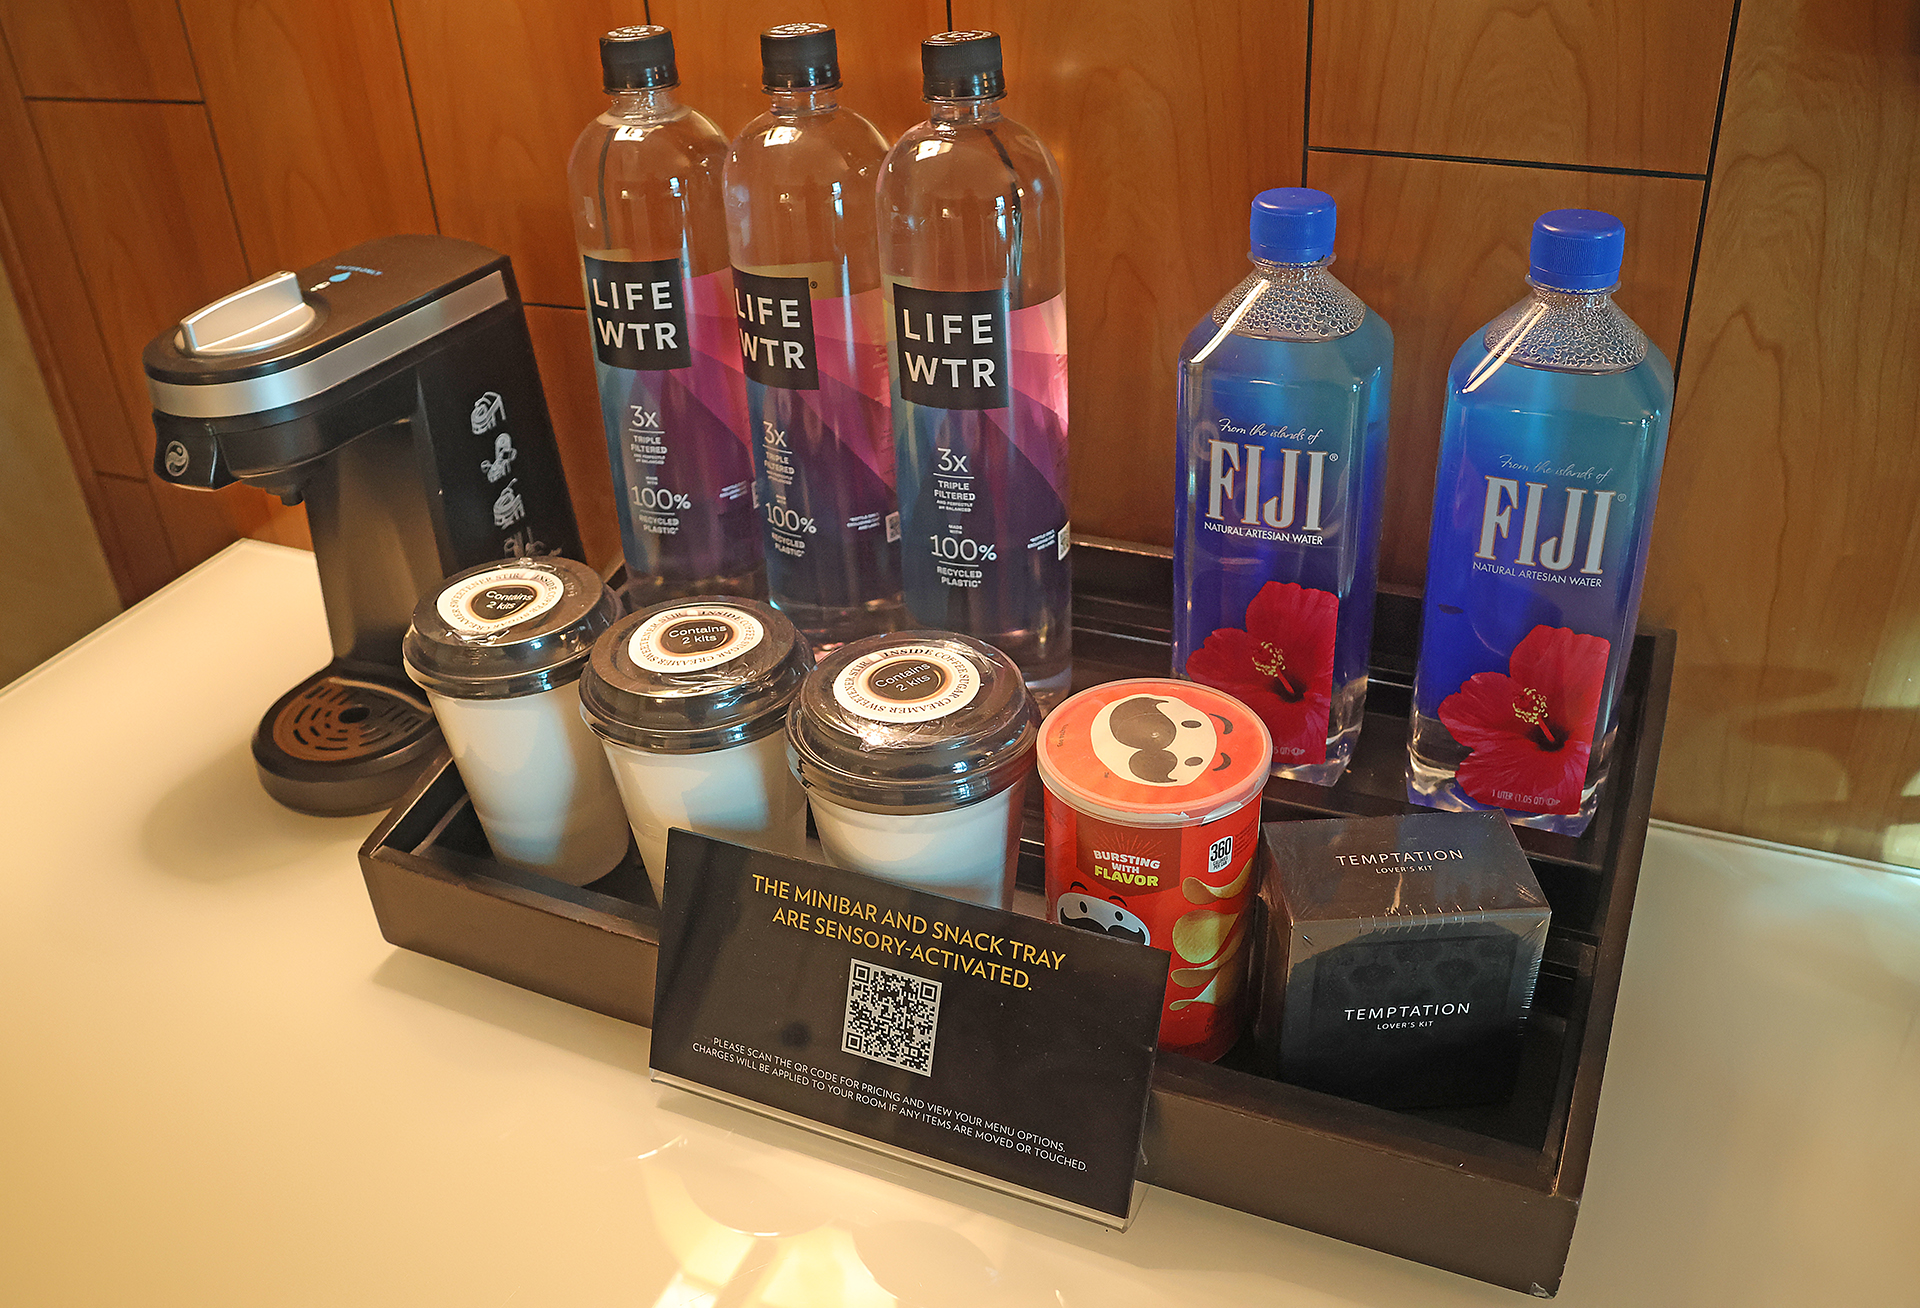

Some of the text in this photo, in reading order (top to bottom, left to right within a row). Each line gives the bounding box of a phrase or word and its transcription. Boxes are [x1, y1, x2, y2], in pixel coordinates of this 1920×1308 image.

[592, 278, 673, 311] LIFE
[734, 287, 801, 328] LIFE
[597, 317, 678, 351] WTR
[903, 308, 994, 345] LIFE
[739, 328, 806, 370] WTR
[904, 351, 996, 389] WTR
[630, 405, 659, 428] 3x
[633, 435, 662, 445] TRIPLE
[763, 420, 787, 447] 3x
[1218, 418, 1324, 445] From the islands of
[630, 443, 668, 454] FILTERED
[765, 451, 789, 464] TRIPLE
[764, 460, 795, 475] FILTERED
[937, 447, 969, 473] 3x
[1499, 454, 1613, 485] From the islands of
[934, 489, 976, 501] FILTERED
[937, 480, 970, 491] TRIPLE
[631, 485, 692, 510] 100%
[638, 514, 680, 527] RECYCLED
[765, 502, 817, 534] 100%
[771, 532, 806, 549] RECYCLED
[1204, 521, 1323, 546] NATURAL ARTESIAN WATER
[929, 534, 998, 561] 100%
[936, 566, 983, 579] RECYCLED
[1472, 561, 1602, 588] NATURAL ARTESIAN WATER
[486, 590, 534, 601] Contains
[486, 601, 516, 610] 2 kits
[668, 625, 727, 638] Contains
[682, 635, 718, 645] 2 kits
[883, 648, 934, 657] INSIDE
[875, 662, 931, 688] Contains
[895, 674, 931, 692] 2 kits
[1093, 850, 1161, 870] BURSTING
[1210, 837, 1232, 862] 360
[1335, 849, 1464, 867] TEMPTATION
[1094, 865, 1159, 887] FLAVOR
[1111, 862, 1140, 874] WITH
[1375, 864, 1434, 875] LOVER'S KIT
[752, 873, 1067, 972] THE MINIBAR AND SNACK TRAY
[772, 907, 1033, 991] ARE SENSORY-ACTIVATED.
[1344, 1002, 1471, 1022] TEMPTATION
[1377, 1020, 1434, 1031] LOVER'S KIT
[713, 1036, 1066, 1153] PLEASE SCAN THE QR CODE FOR PRICING AND VIEW YOUR MENU OPTIONS.
[692, 1042, 1089, 1173] CHARGES WILL BE APPLIED TO YOUR ROOM IF ANY ITEMS ARE MOVED OR TOUCHED.
